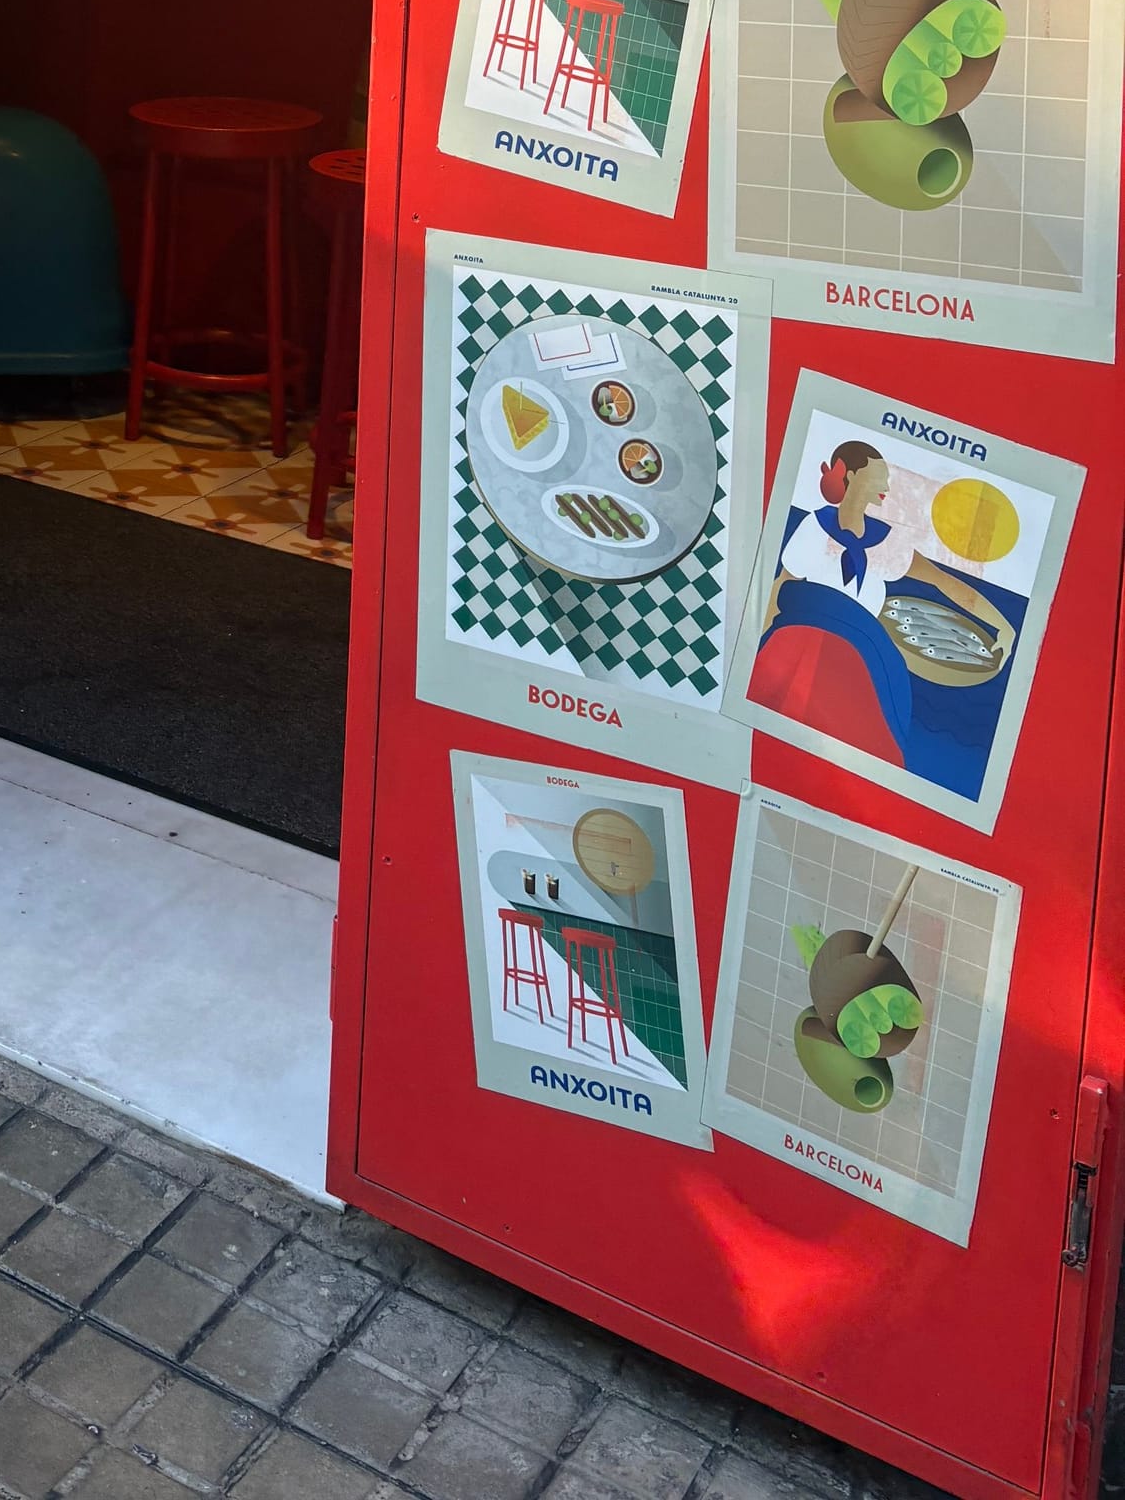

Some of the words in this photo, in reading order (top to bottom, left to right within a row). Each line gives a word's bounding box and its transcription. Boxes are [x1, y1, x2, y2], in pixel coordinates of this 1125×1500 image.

[495, 130, 619, 182] ANXOITA
[453, 254, 484, 264] ANXOITA
[651, 285, 681, 295] RAMBLA
[683, 290, 726, 302] CATALUNYA
[825, 282, 975, 322] BARCELONA
[880, 412, 987, 462] ANXOITA
[527, 684, 623, 729] BODEGA
[546, 776, 580, 789] BODEGA
[530, 1065, 652, 1117] ANXOITA
[783, 1133, 884, 1194] BARCELONA
